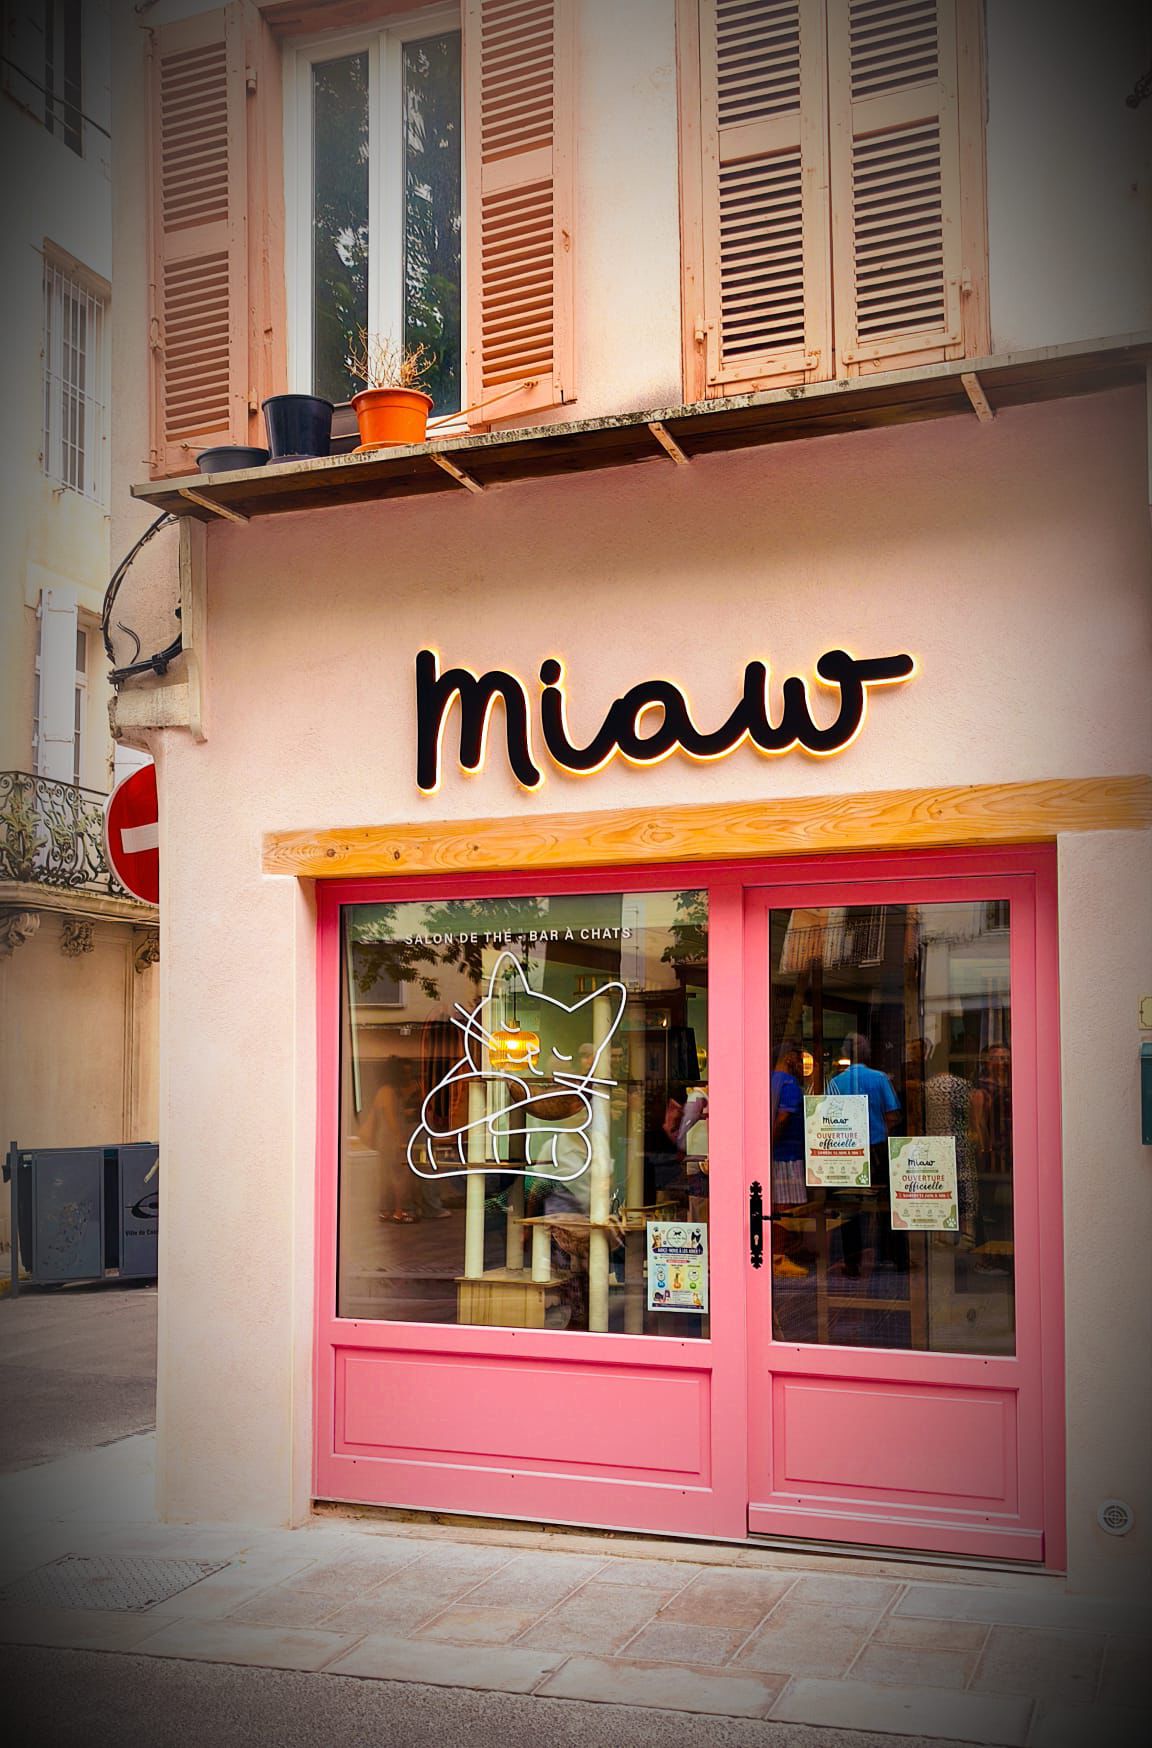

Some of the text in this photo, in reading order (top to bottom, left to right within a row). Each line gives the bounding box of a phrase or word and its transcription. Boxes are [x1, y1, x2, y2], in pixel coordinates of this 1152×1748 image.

[416, 649, 914, 791] miaw
[405, 934, 454, 946] SALON
[460, 932, 479, 944] DE
[484, 928, 513, 944] THÉ
[529, 929, 560, 942] BAR
[565, 926, 576, 940] À
[580, 927, 634, 940] CHATS
[819, 1139, 857, 1149] officielle
[904, 1181, 944, 1192] officielle
